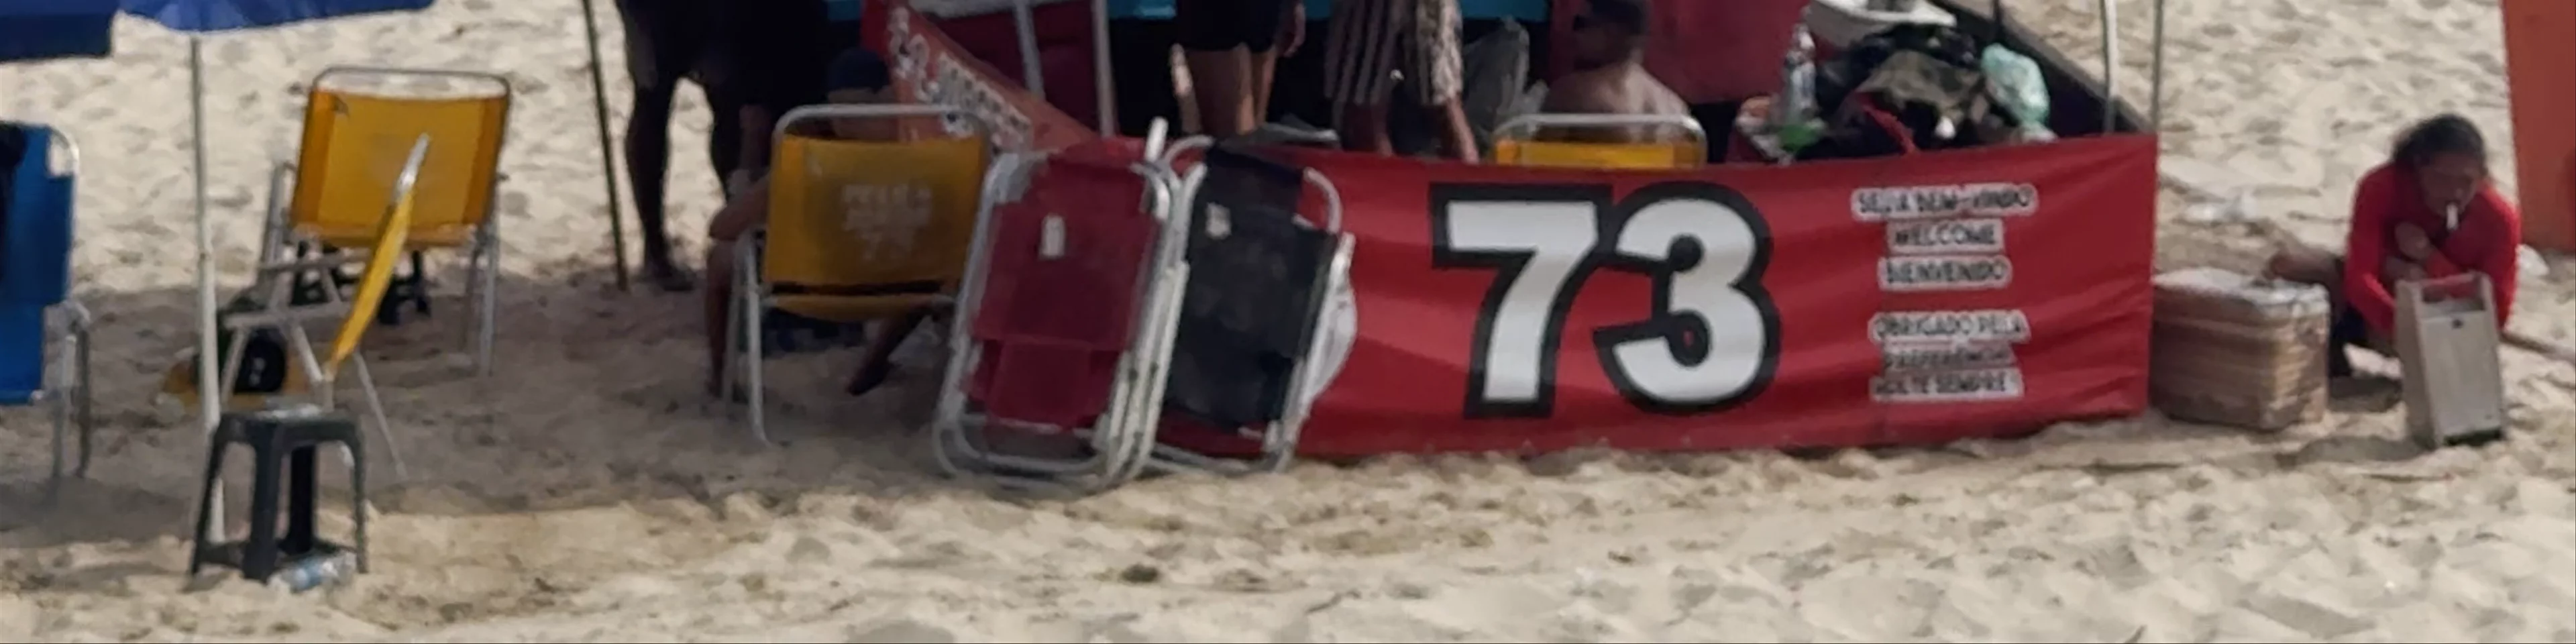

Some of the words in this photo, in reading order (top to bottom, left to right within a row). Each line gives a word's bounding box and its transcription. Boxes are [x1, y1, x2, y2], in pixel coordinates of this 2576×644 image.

[1895, 225, 1995, 245] WELCOME
[1886, 259, 2007, 283] BIENVENIDO
[1431, 182, 1780, 417] 73
[1874, 314, 1974, 337] OBRIGADO
